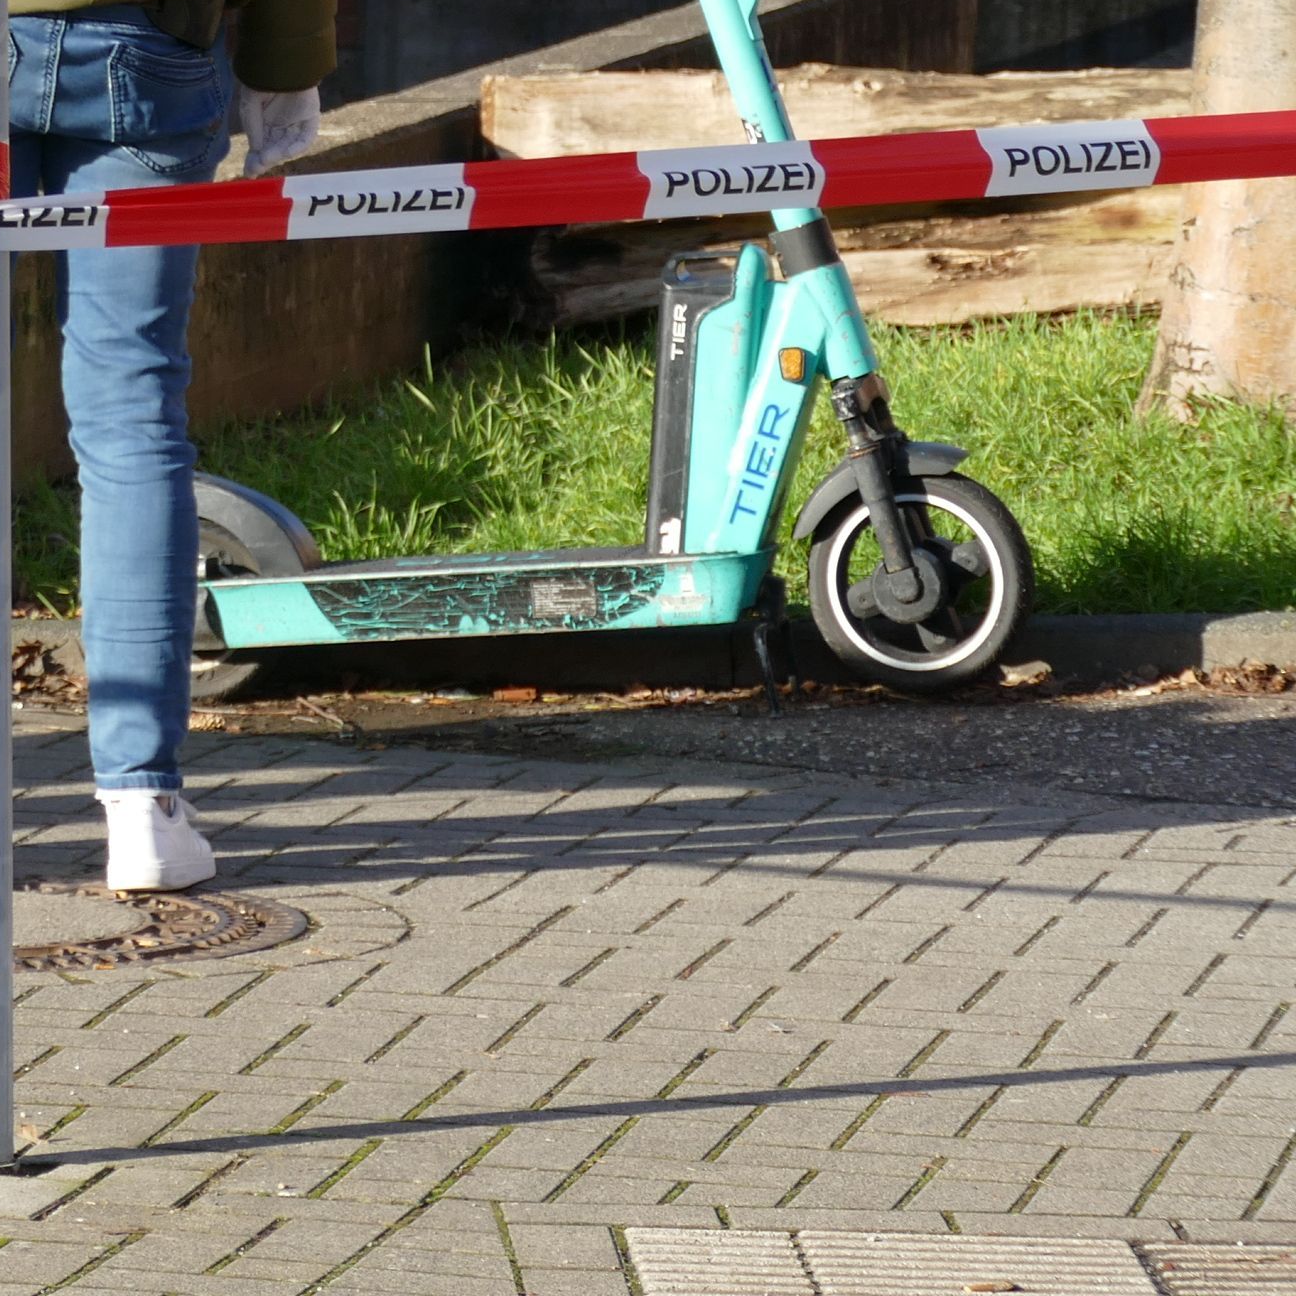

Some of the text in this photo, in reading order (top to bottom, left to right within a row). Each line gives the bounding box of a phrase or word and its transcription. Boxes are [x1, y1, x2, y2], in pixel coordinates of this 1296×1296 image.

[1003, 139, 1152, 178] POLIZEI
[663, 162, 816, 198] POLIZEI
[307, 186, 465, 217] POLIZEI
[670, 303, 688, 361] TIER
[729, 403, 790, 524] TIER
